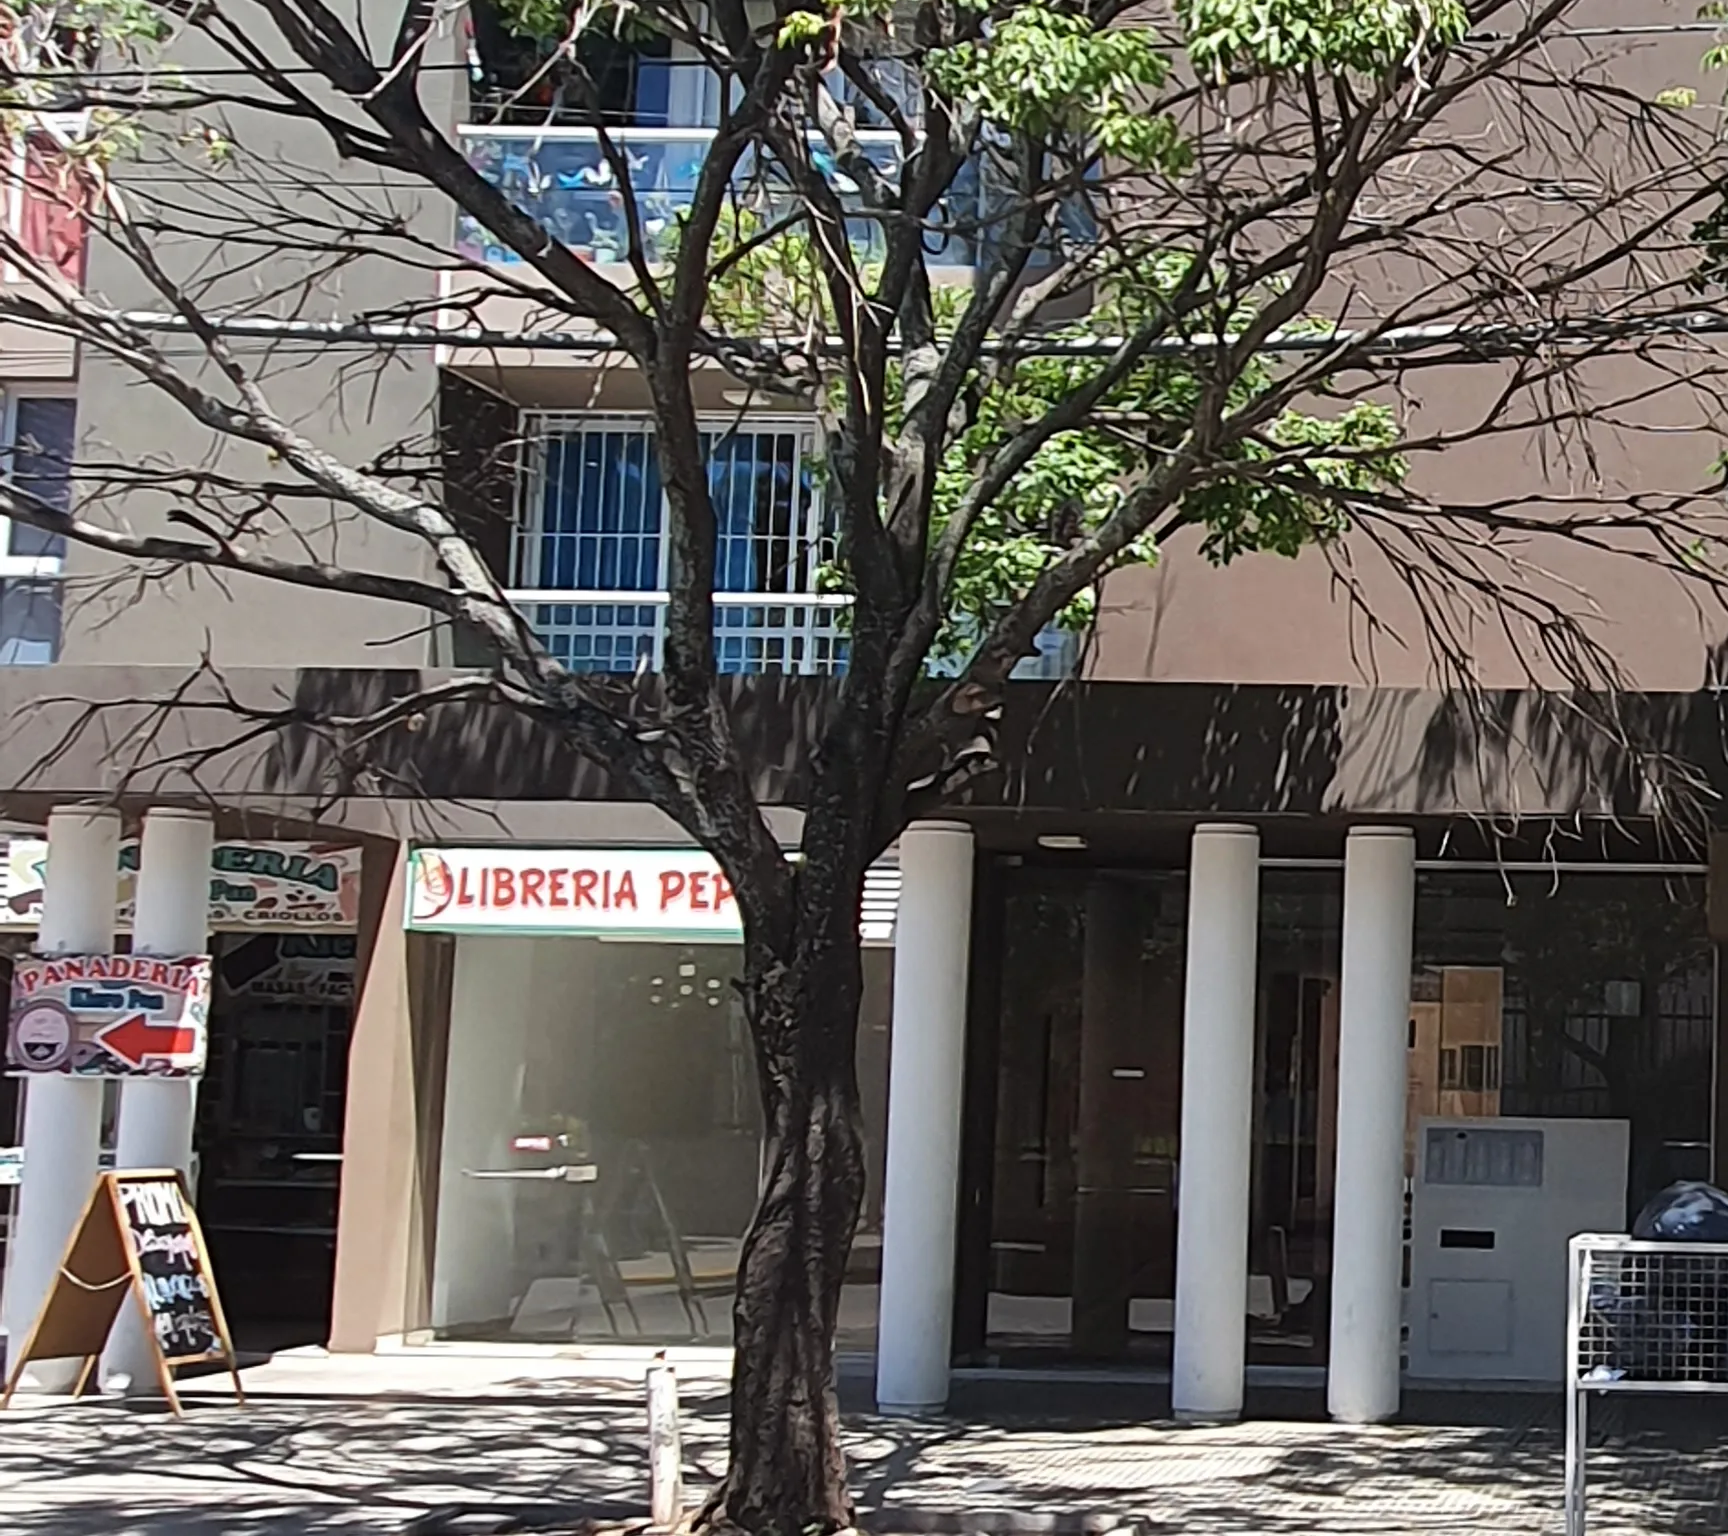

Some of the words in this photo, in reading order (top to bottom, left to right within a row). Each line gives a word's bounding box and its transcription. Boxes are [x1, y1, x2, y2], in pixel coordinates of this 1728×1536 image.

[457, 867, 638, 909] LIBRERIA
[659, 870, 736, 911] PEP
[243, 910, 344, 922] CRIOLLOS
[23, 957, 198, 996] PANADERIA
